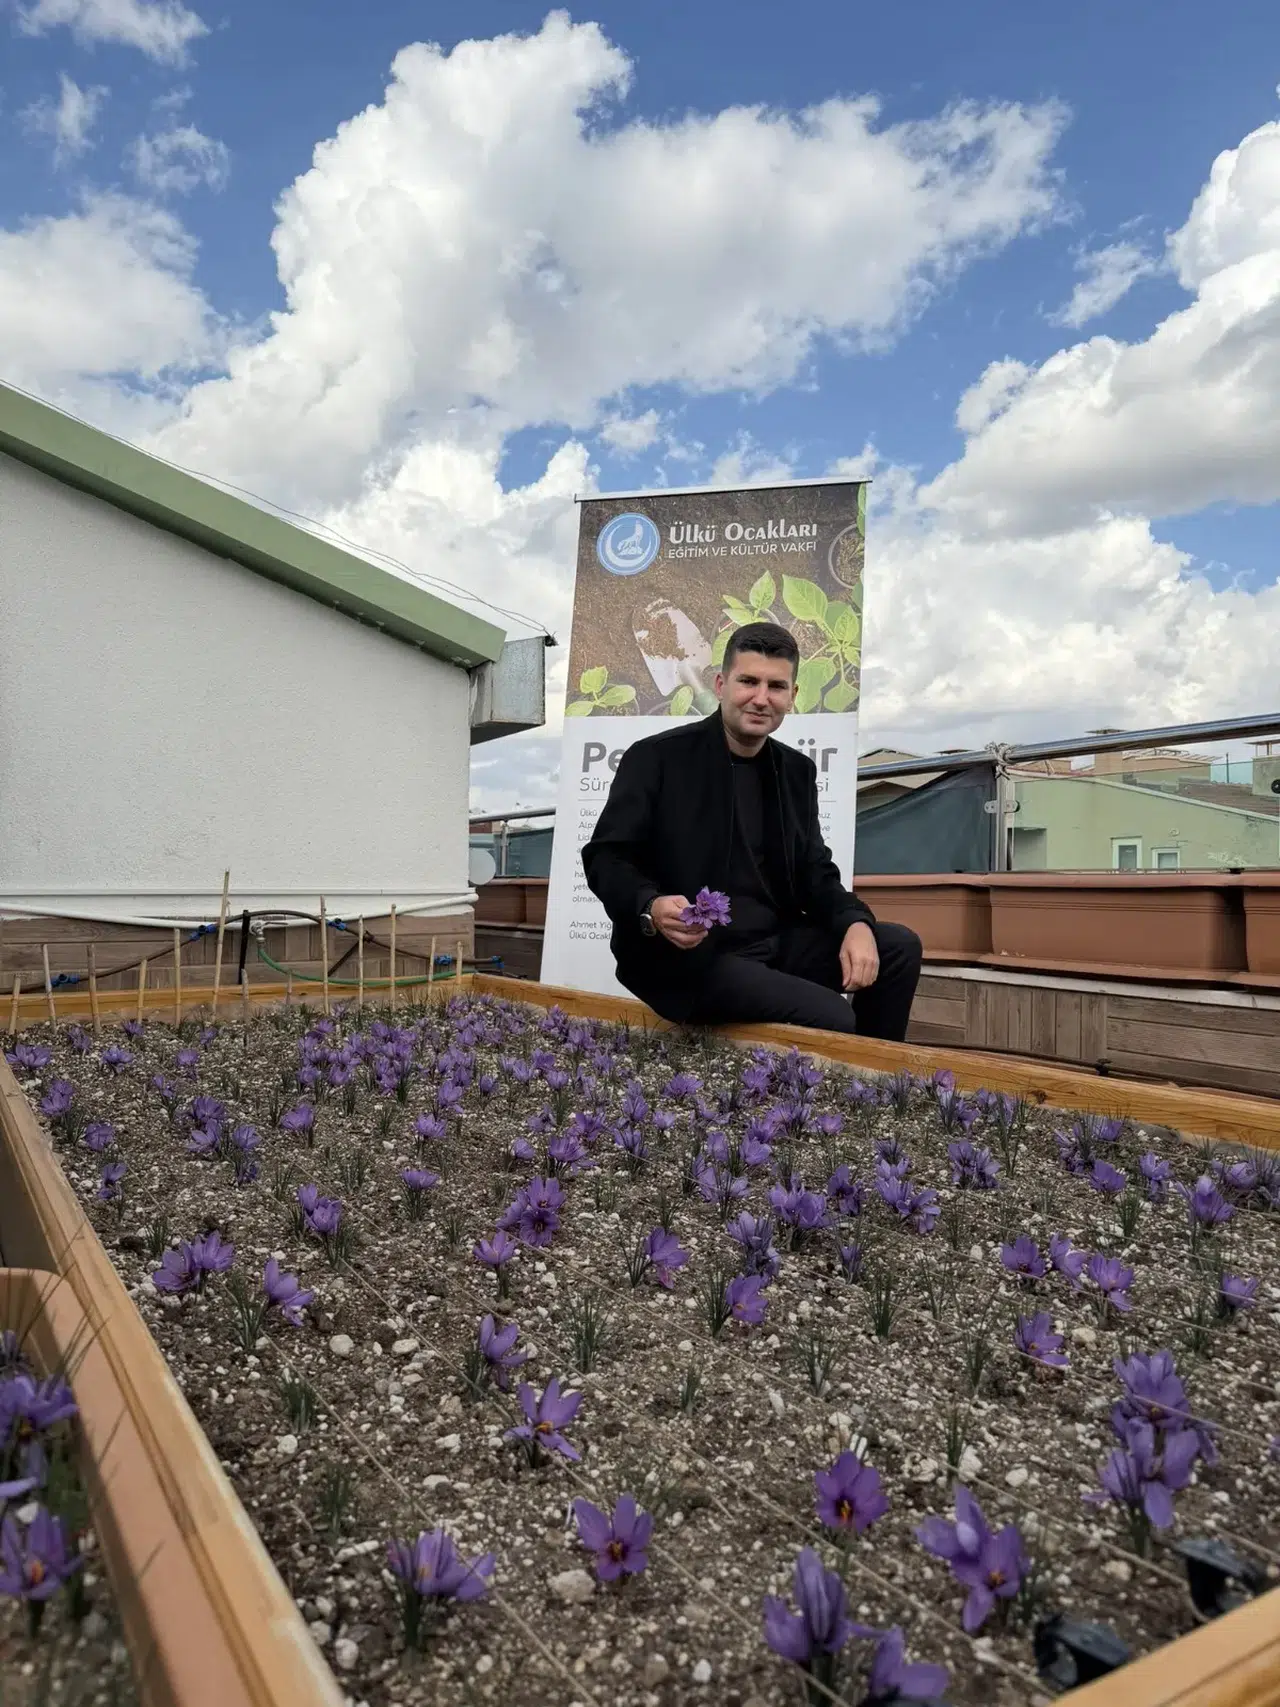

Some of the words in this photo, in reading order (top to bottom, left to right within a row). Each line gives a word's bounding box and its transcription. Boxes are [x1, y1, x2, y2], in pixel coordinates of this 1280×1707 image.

[669, 521, 716, 544] Ülkü
[668, 545, 709, 559] EĞİTİM
[711, 546, 728, 557] VE
[730, 542, 778, 555] KÜLTÜR
[780, 541, 817, 553] VAKFI
